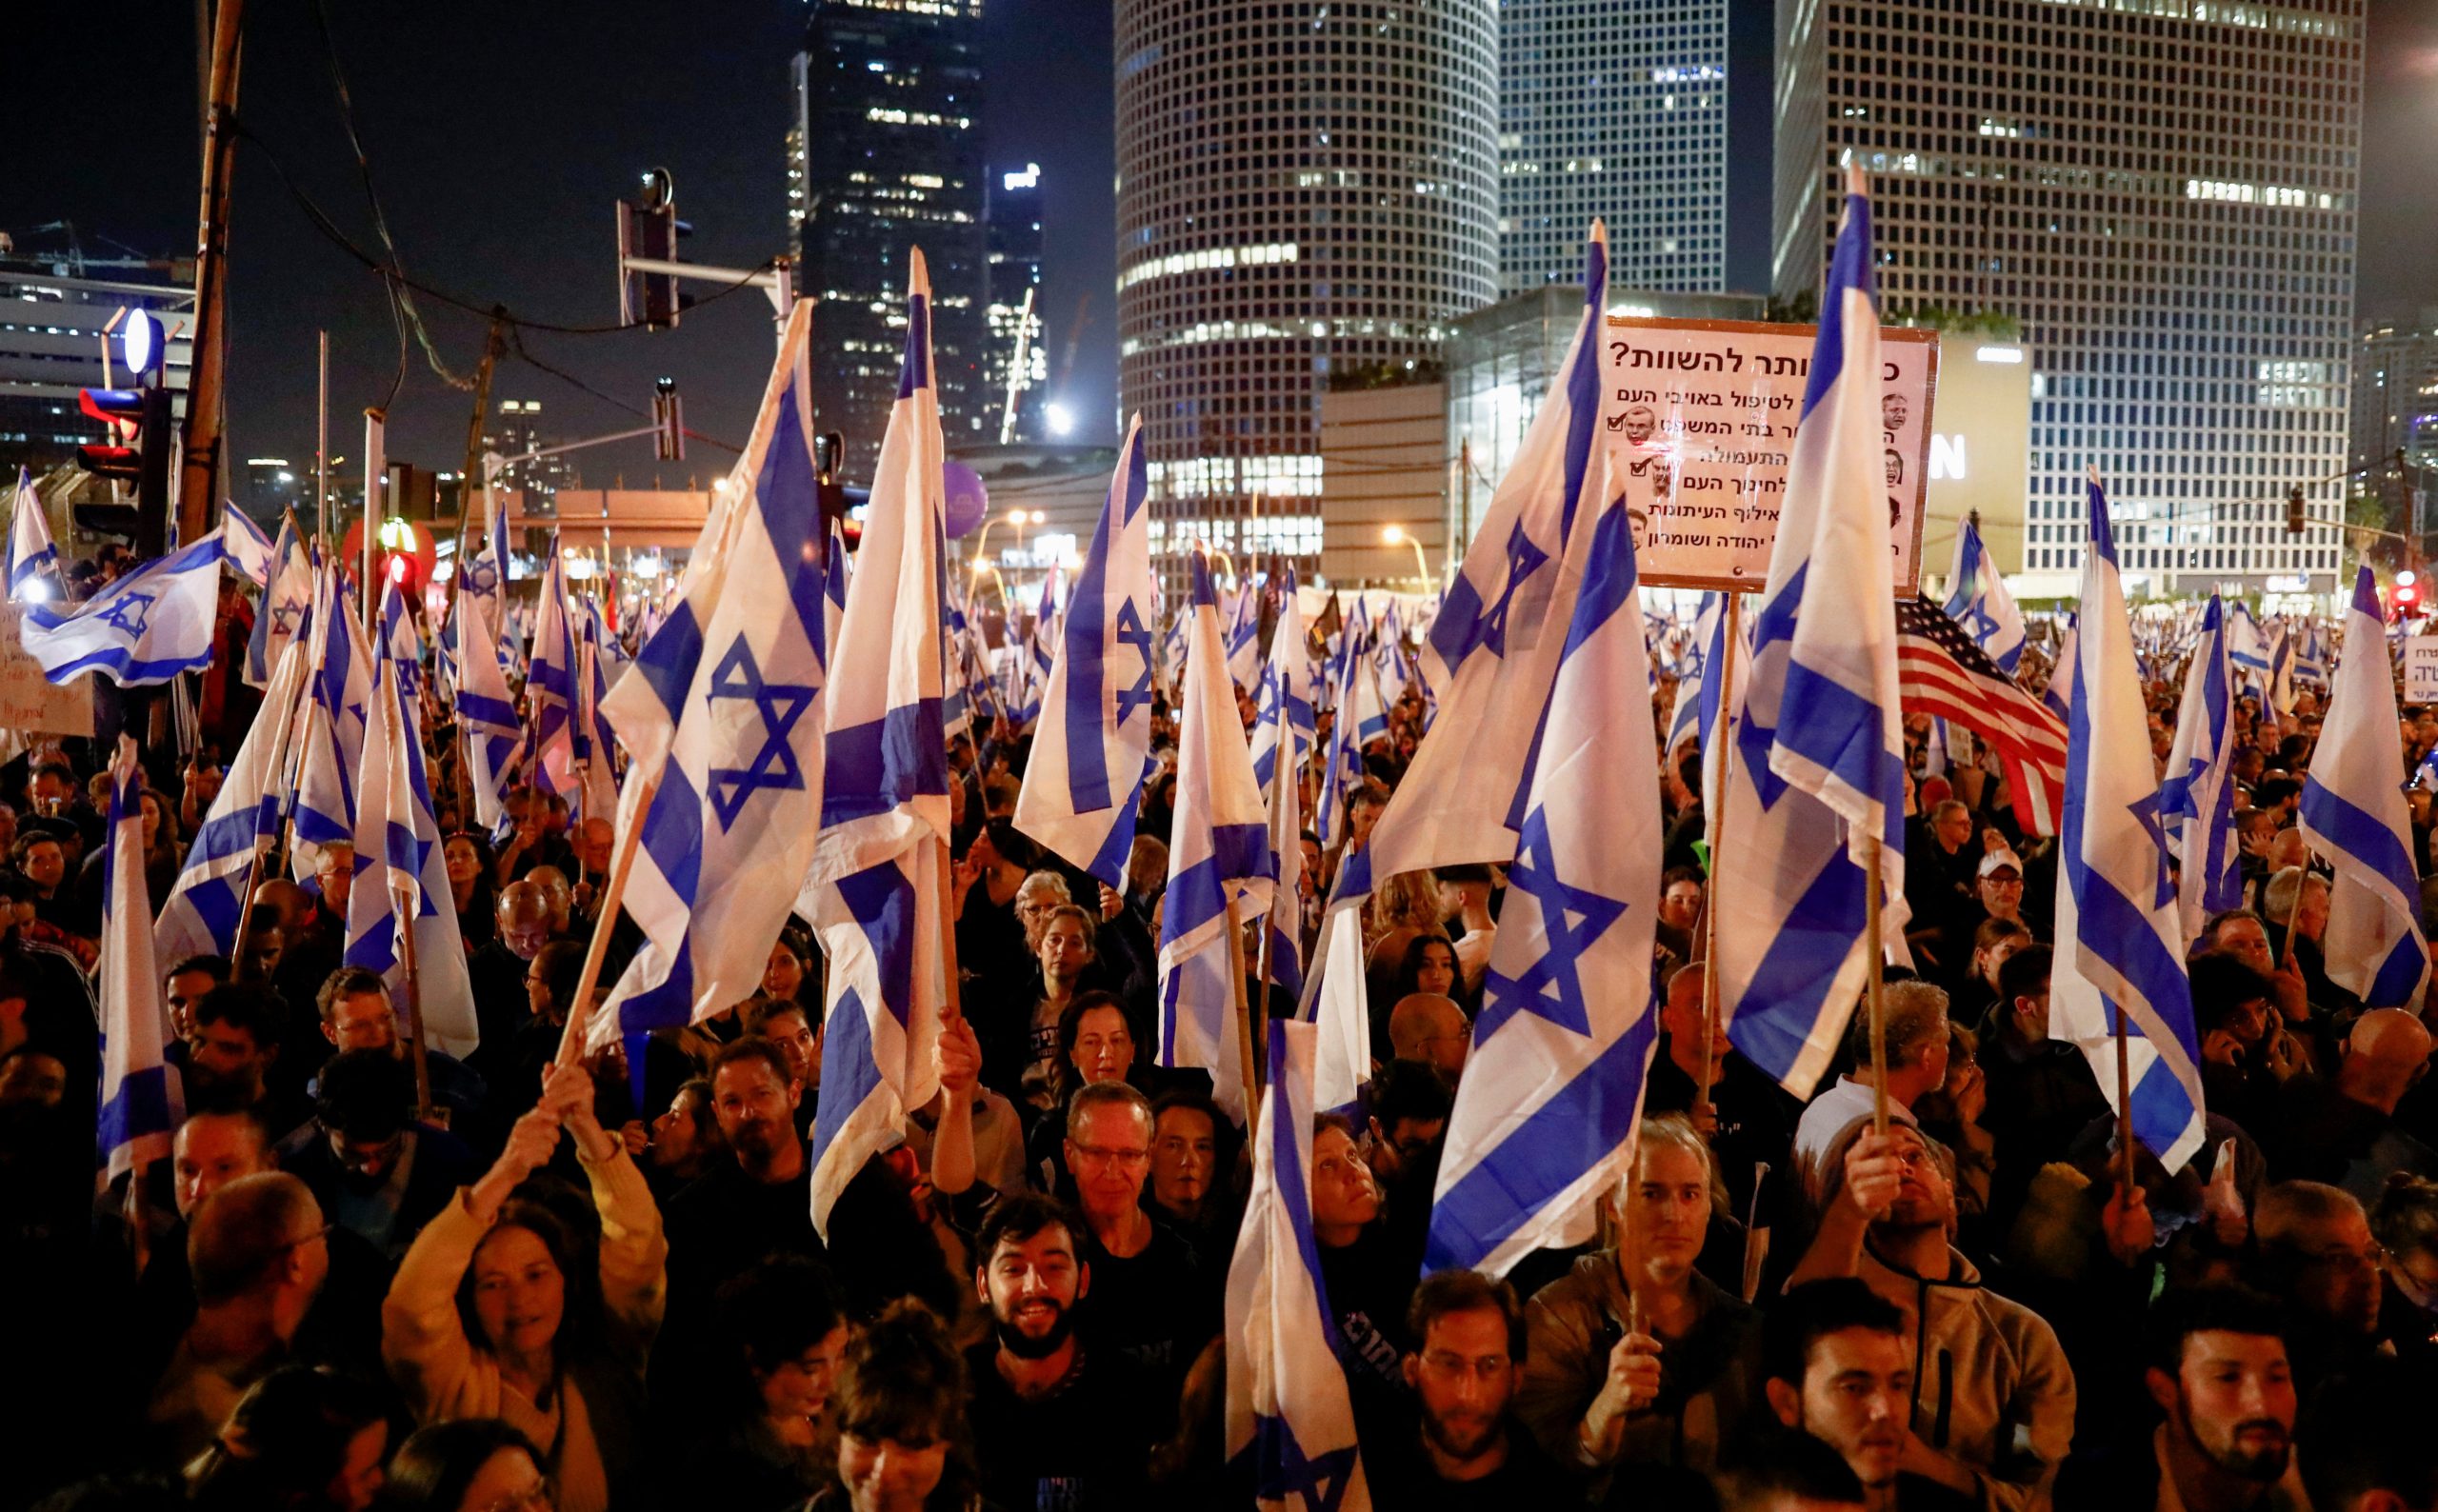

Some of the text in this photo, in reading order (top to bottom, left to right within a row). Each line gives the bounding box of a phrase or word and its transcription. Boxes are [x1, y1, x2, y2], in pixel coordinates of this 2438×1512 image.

[1609, 342, 1814, 377] ותר להשוות?
[1617, 388, 1657, 403] העם
[1730, 390, 1794, 409] לטיפול
[1740, 423, 1774, 437] בתי
[1700, 446, 1789, 466] התעמולה
[1683, 476, 1723, 490] העם
[1648, 504, 1727, 519] העיתונות
[1648, 533, 1710, 547] ושומרון
[1716, 535, 1765, 549] יהודה
